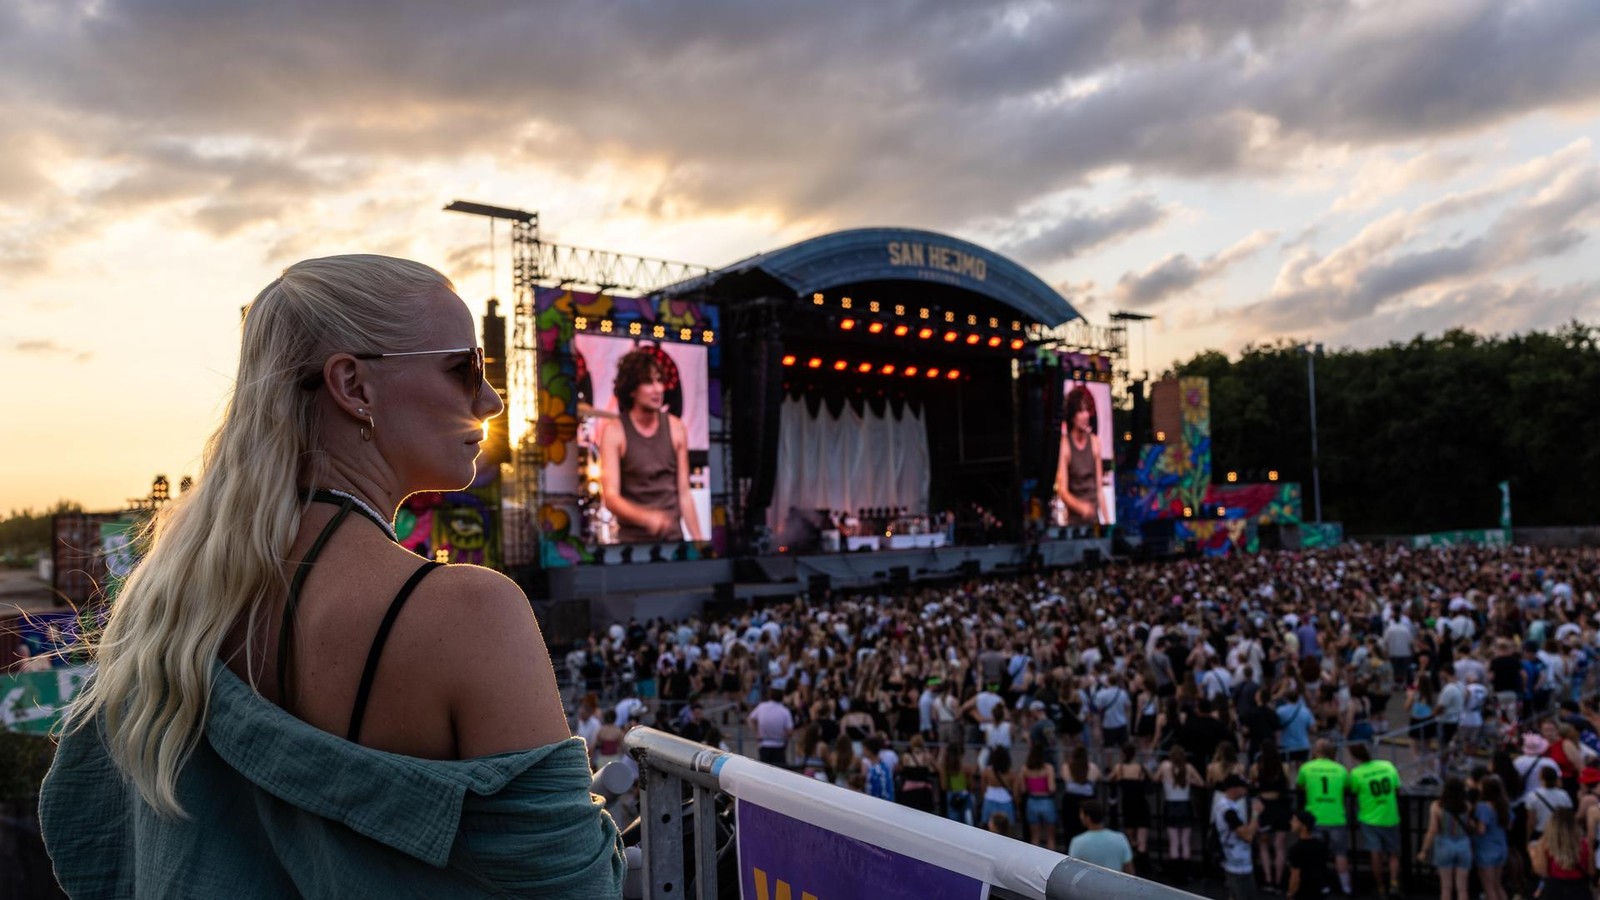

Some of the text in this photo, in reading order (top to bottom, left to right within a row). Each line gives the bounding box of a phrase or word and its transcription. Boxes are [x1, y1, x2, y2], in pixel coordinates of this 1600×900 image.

[887, 241, 925, 267] SAN
[927, 245, 987, 281] HEJMO
[1320, 776, 1329, 795] 1
